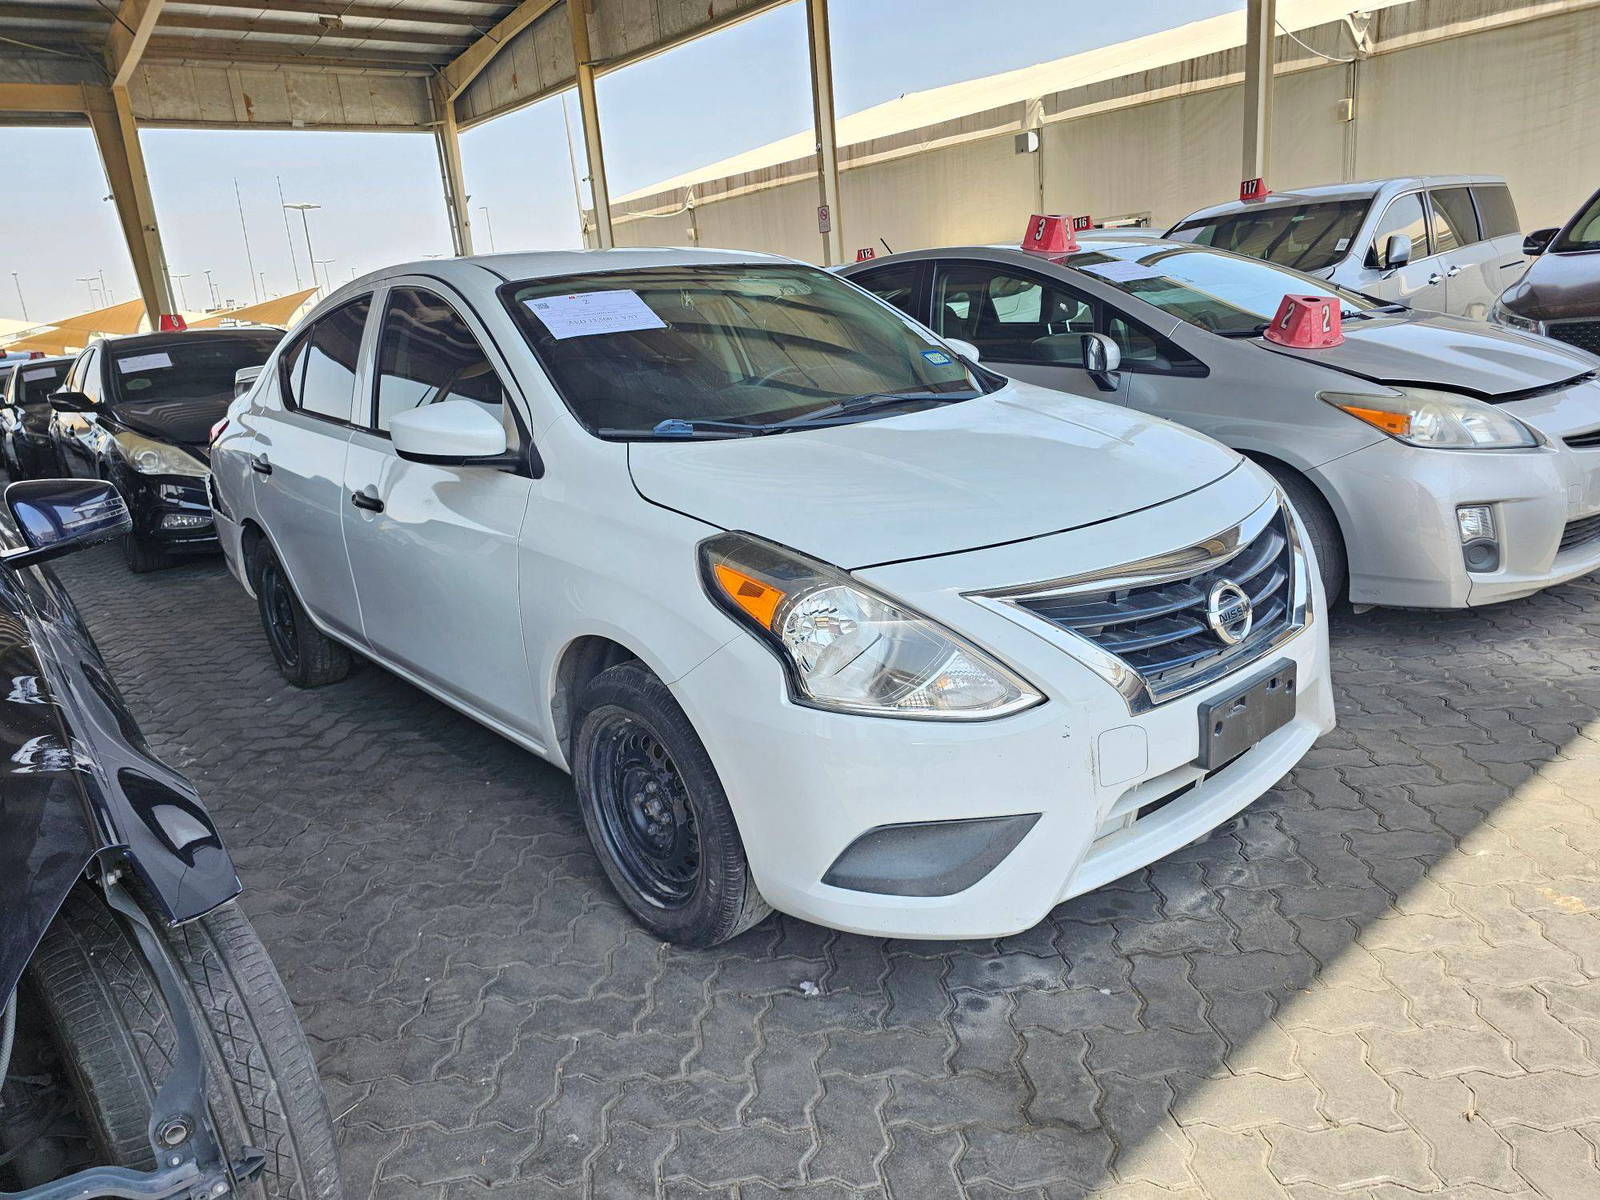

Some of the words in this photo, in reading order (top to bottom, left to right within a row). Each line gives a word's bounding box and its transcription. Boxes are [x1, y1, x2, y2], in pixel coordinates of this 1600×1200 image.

[1243, 181, 1257, 194] 117
[1035, 218, 1046, 240] 3
[1073, 217, 1087, 229] 116
[171, 316, 179, 327] 8
[1280, 302, 1296, 329] 2
[1322, 305, 1331, 333] 2
